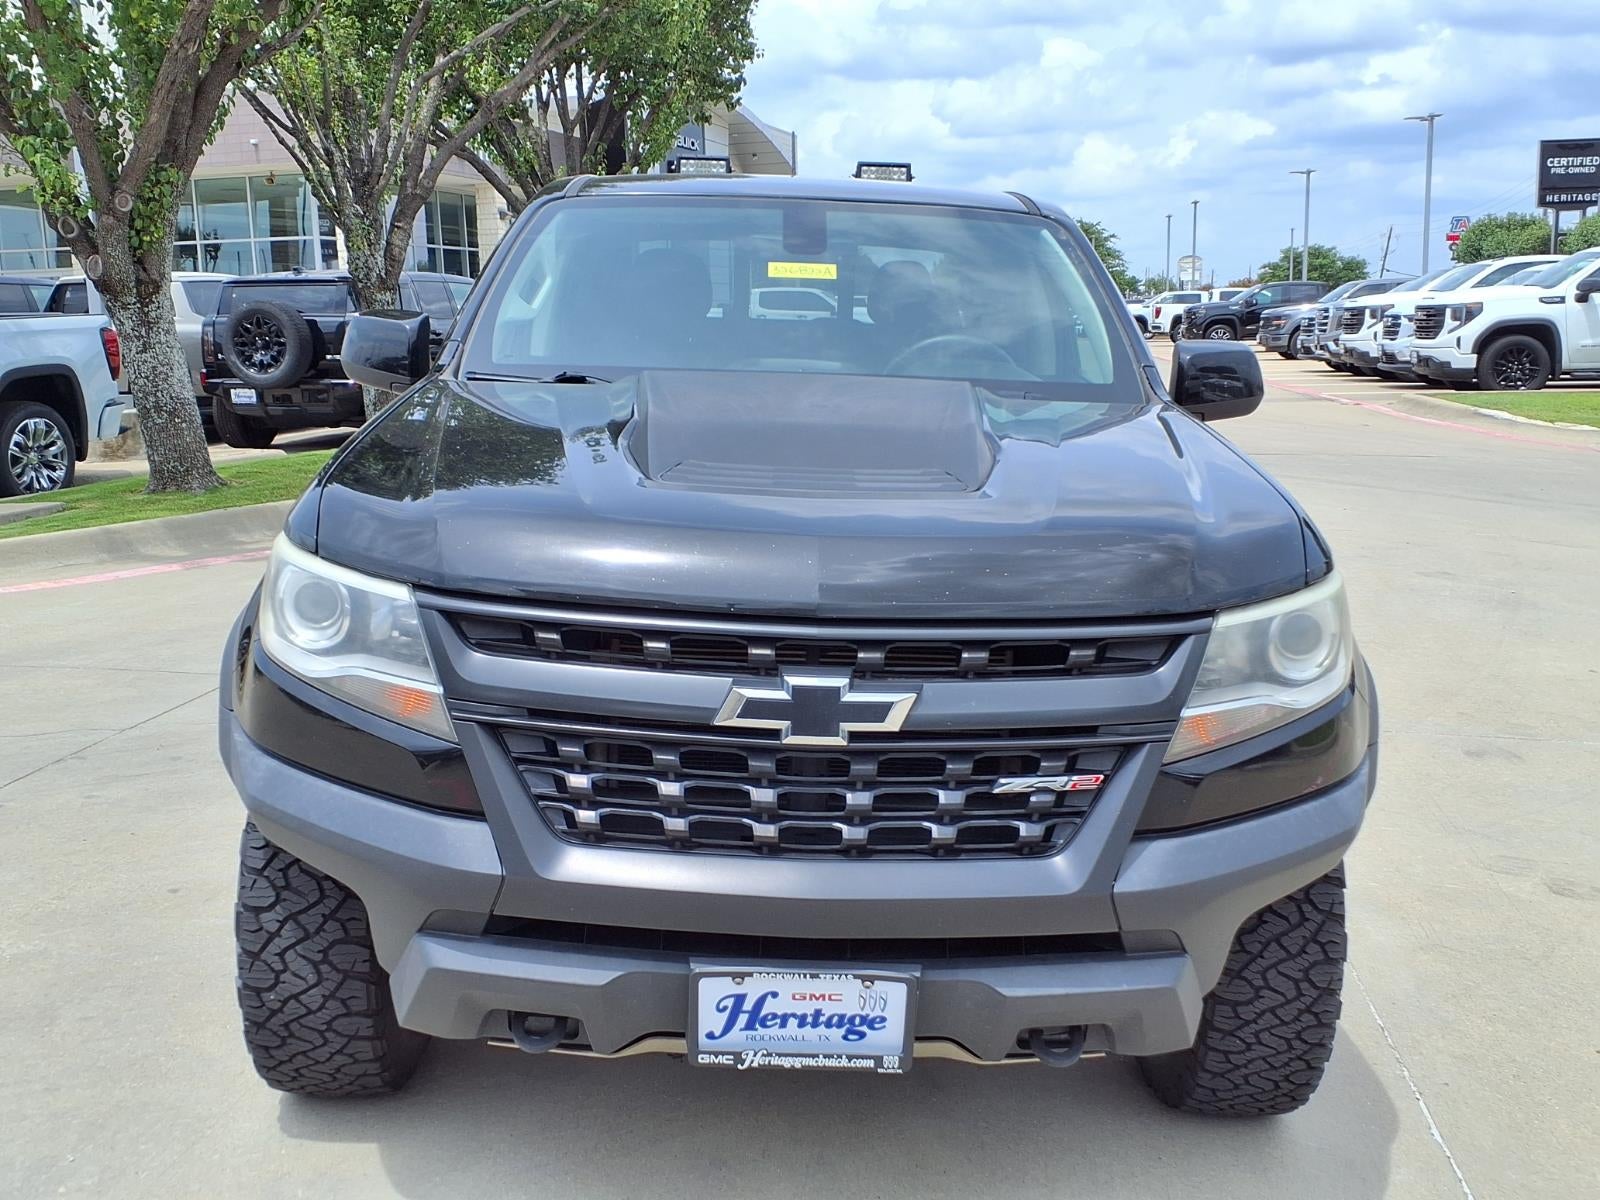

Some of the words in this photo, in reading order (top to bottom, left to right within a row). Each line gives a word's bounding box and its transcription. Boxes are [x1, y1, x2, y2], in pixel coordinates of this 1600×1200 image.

[1546, 156, 1600, 167] CERTIFIED
[1550, 166, 1596, 174] PRE-OWNED
[1546, 193, 1598, 202] HERITAGE
[992, 775, 1105, 793] ZR2
[819, 974, 854, 982] TEXAS
[791, 992, 843, 1002] GMC
[705, 990, 888, 1042] Heritage
[817, 1034, 831, 1042] TX
[697, 1053, 734, 1065] GMC
[736, 1048, 875, 1070] Heritagegmcbuick.com
